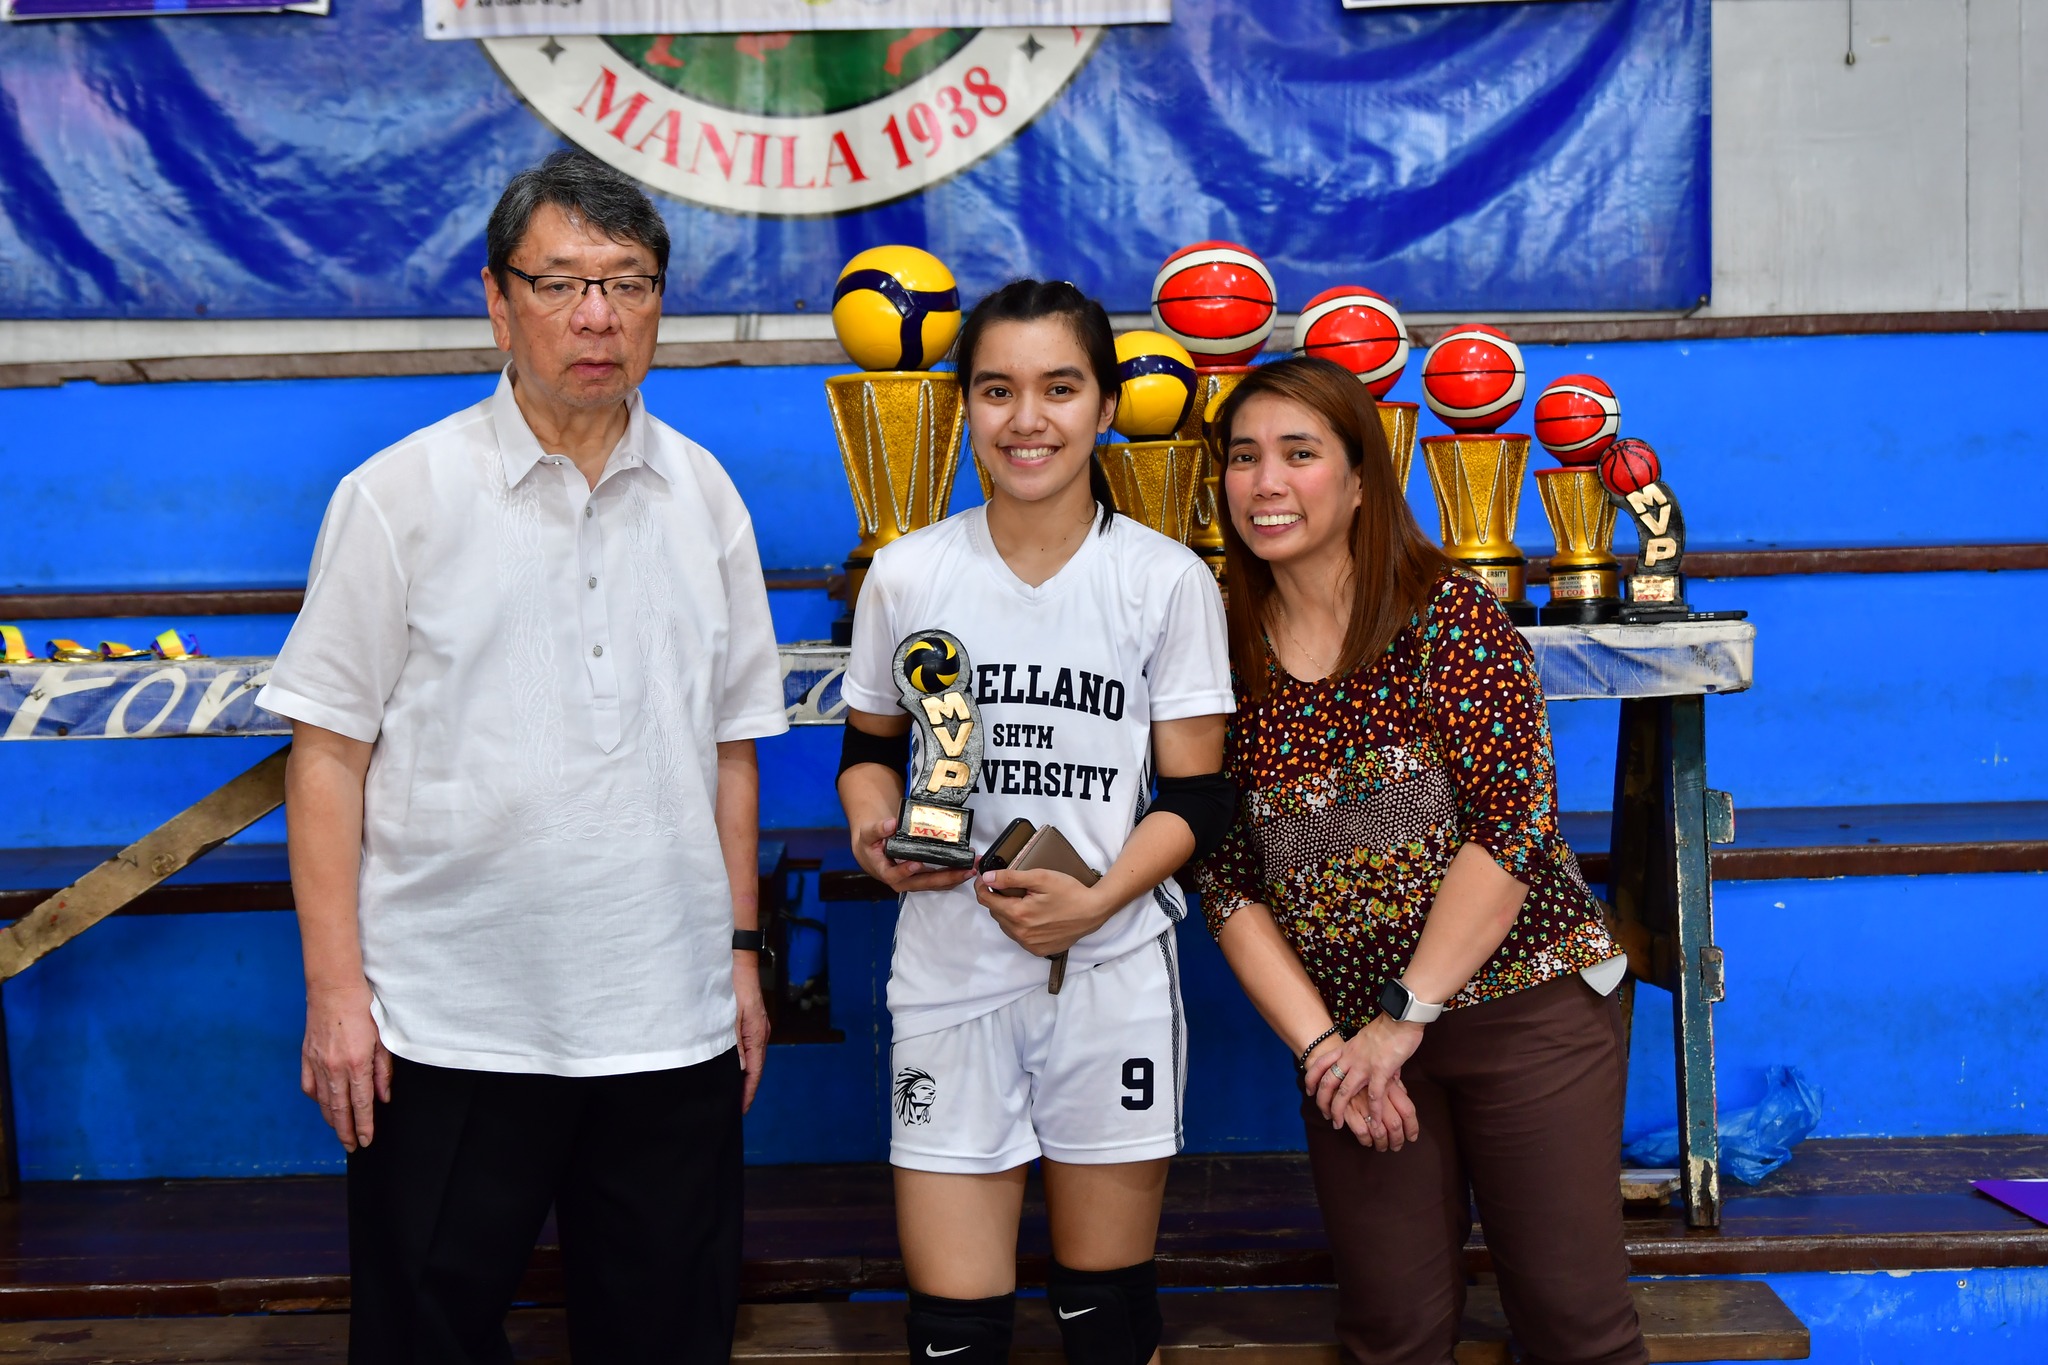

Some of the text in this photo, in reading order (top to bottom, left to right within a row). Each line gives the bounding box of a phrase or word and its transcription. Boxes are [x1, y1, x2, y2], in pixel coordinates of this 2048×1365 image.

[573, 65, 1008, 189] MANILA 1938
[1625, 482, 1677, 568] MVP
[967, 663, 1125, 722] ELLANO
[920, 691, 974, 793] MVP
[992, 723, 1054, 749] SHTM
[971, 759, 1118, 802] VERSITY
[1121, 1057, 1154, 1110] 9
